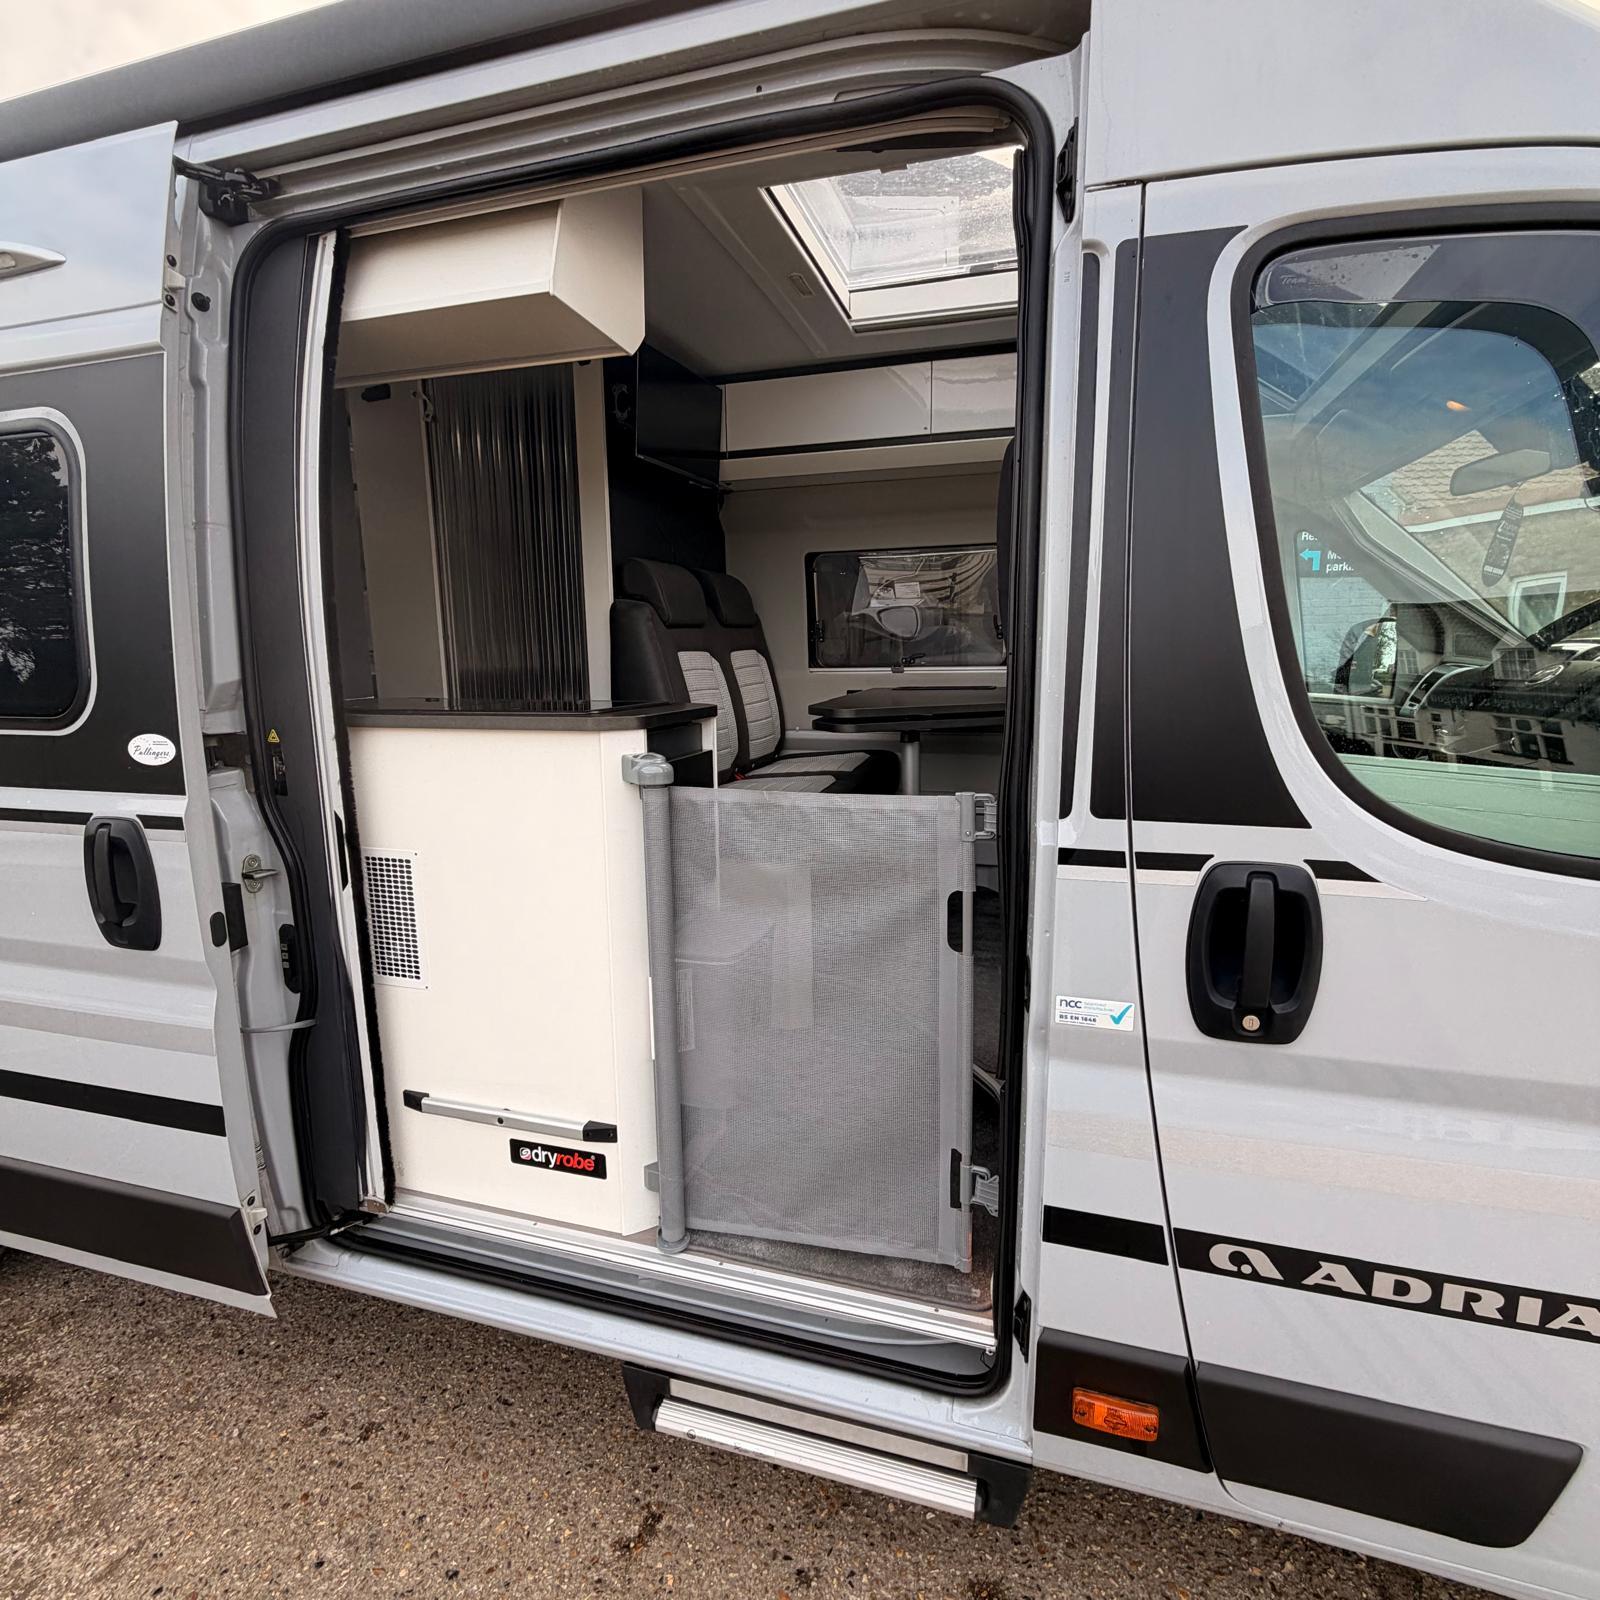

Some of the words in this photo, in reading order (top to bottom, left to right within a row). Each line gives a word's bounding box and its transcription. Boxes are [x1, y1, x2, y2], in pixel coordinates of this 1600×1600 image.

[1301, 531, 1318, 541] Re
[1327, 550, 1342, 560] M
[1059, 999, 1082, 1009] ncc
[1302, 1261, 1600, 1337] ADRIA
